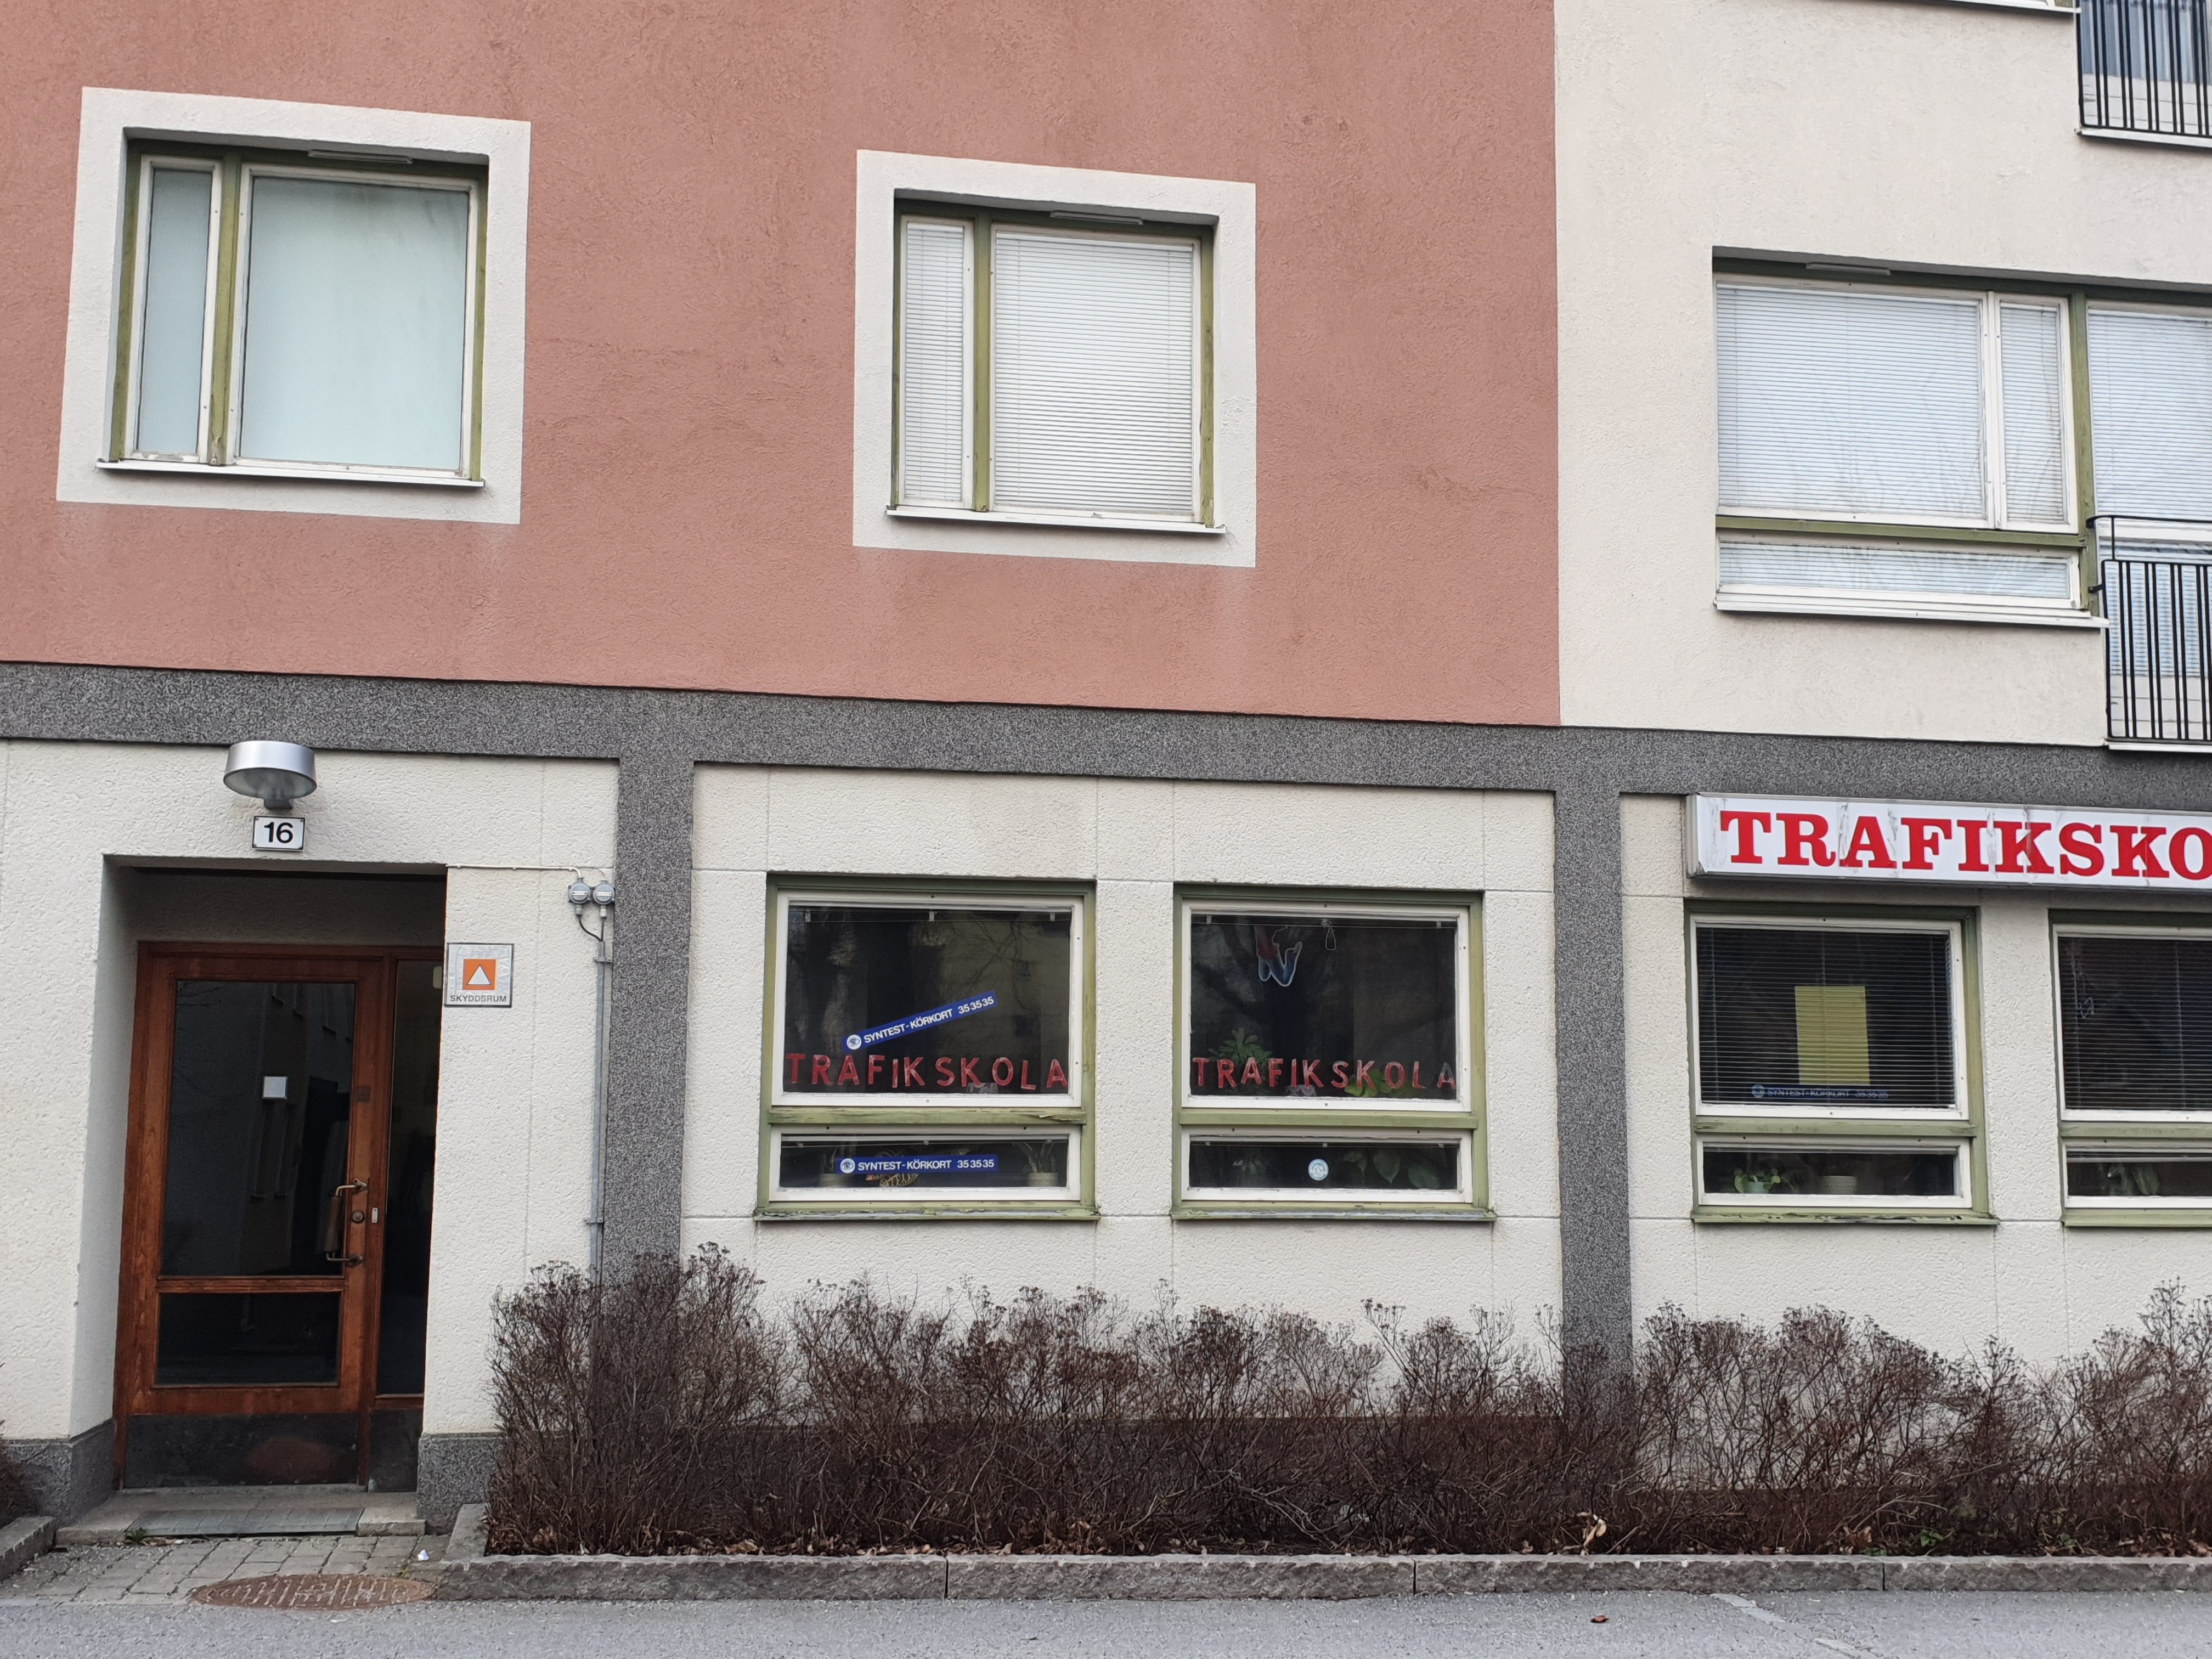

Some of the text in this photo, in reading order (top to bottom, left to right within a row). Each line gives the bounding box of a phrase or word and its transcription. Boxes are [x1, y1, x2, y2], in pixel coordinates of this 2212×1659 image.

[263, 821, 294, 844] 16
[1720, 810, 2212, 881] TRAFIKSKO
[449, 994, 507, 1003] SKYDDSRUM
[863, 1008, 953, 1044] SYNTEST-KÖRKORT
[786, 1053, 1068, 1090] TRAFIKSKOLA
[1192, 1057, 1457, 1090] TRAFIKSKOLA
[857, 1159, 952, 1171] SYNTEST-KÖRKORT
